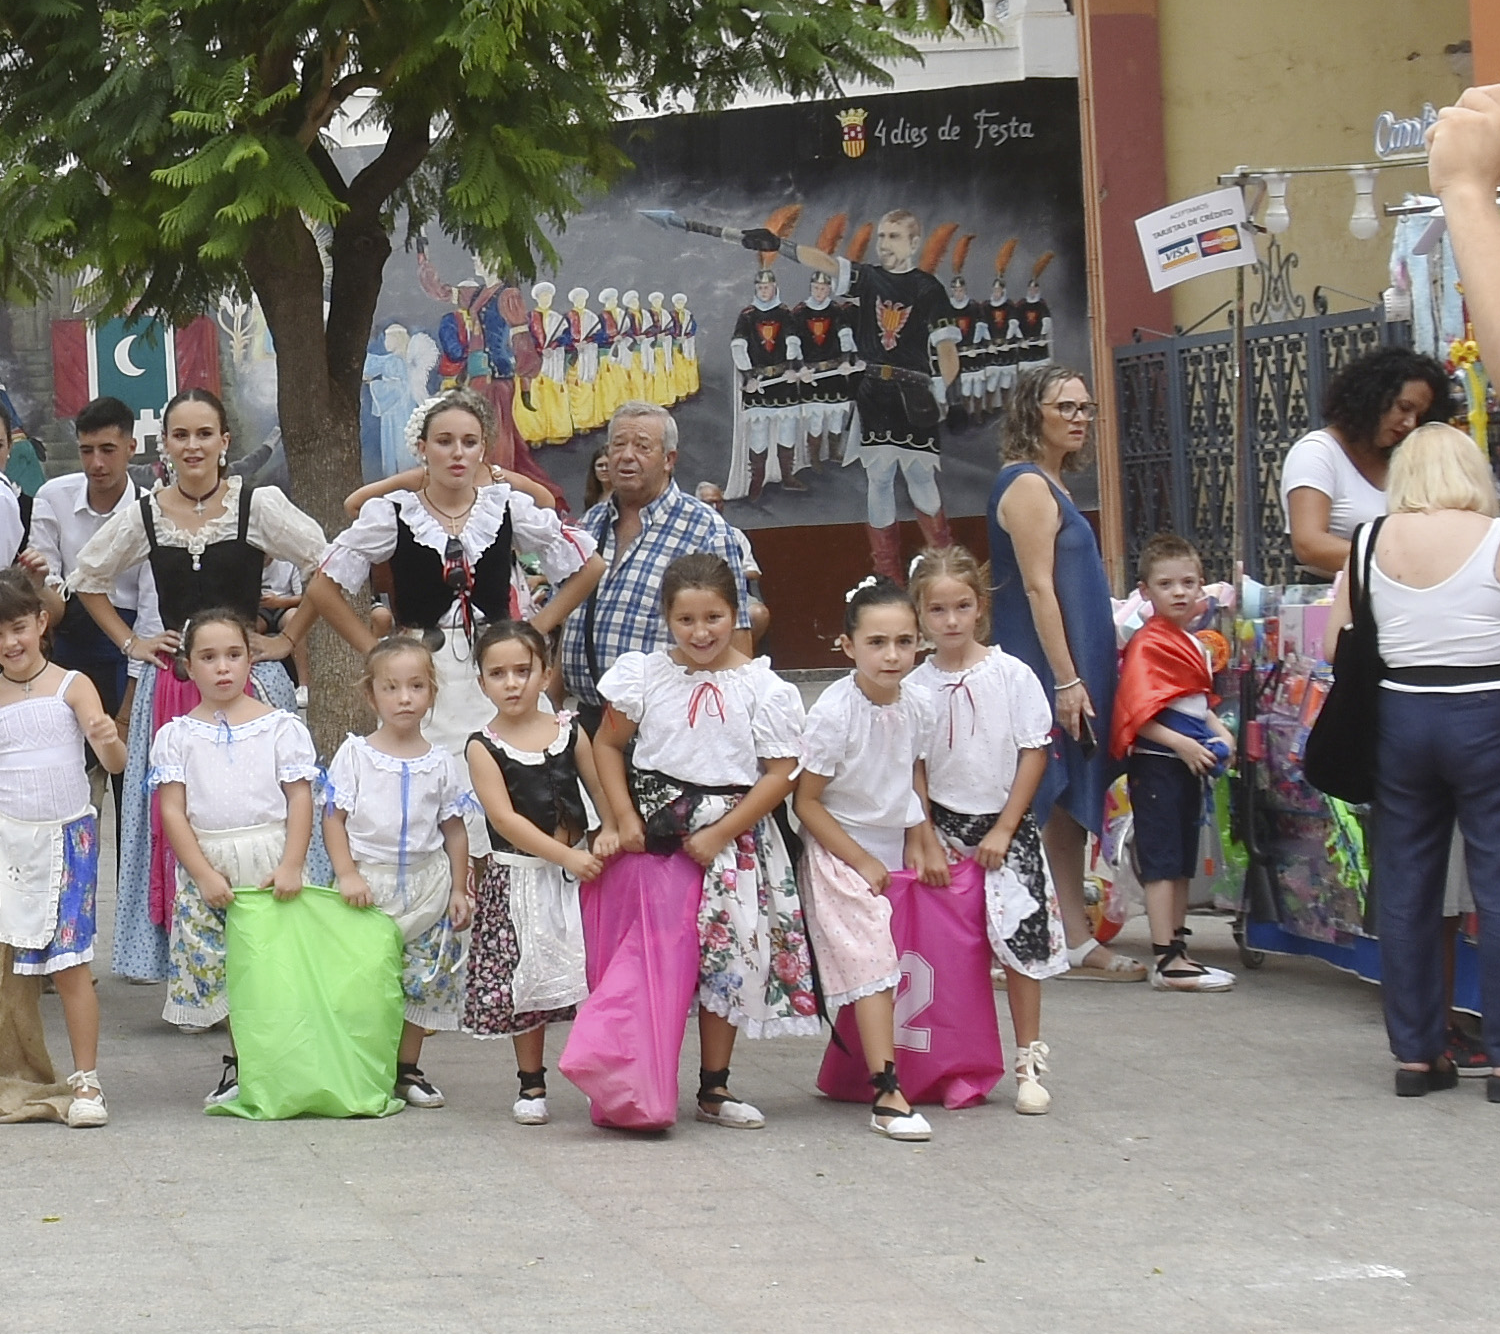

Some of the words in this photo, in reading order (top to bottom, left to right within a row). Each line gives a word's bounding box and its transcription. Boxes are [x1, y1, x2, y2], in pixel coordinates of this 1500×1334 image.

[890, 117, 929, 149] dies
[938, 114, 961, 141] de
[973, 108, 1035, 149] Festa
[1187, 217, 1199, 227] DE
[1164, 245, 1191, 262] VISA
[892, 949, 935, 1054] 2
